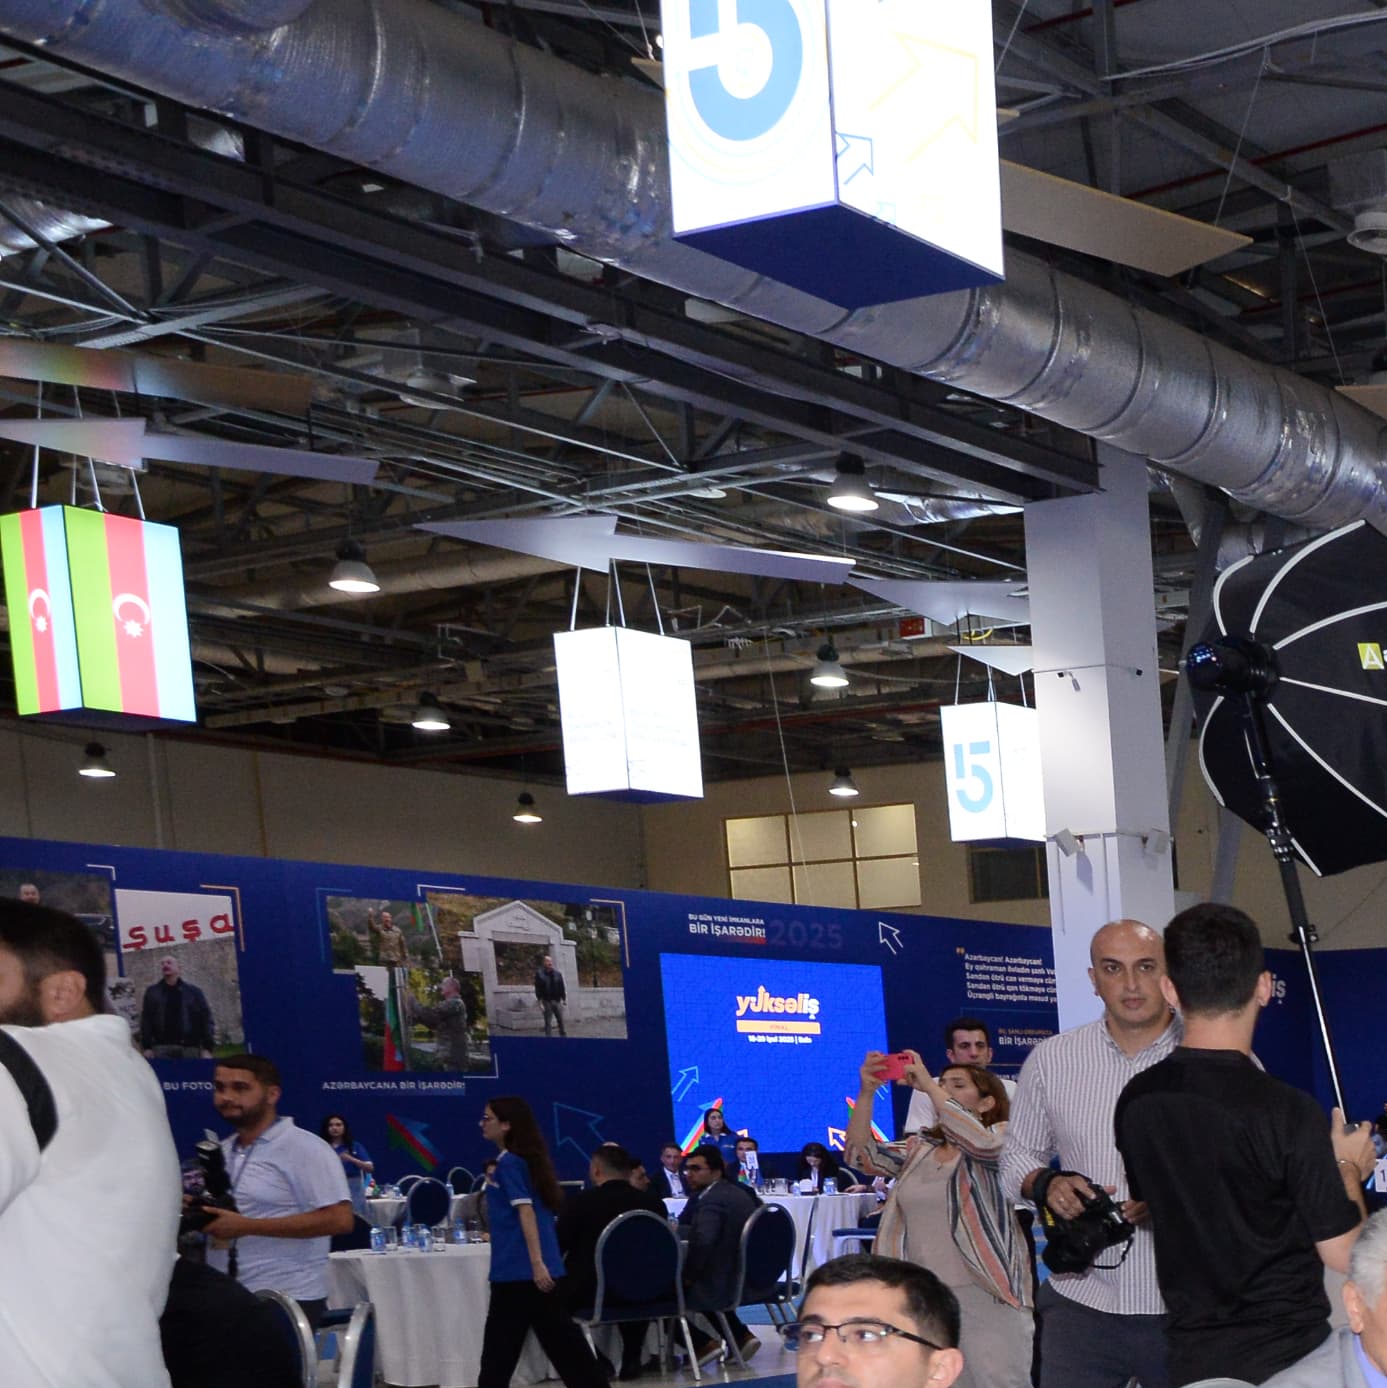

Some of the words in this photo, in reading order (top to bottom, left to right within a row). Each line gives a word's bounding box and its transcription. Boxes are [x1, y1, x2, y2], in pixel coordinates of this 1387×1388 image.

[689, 921, 709, 934] BİR
[711, 922, 766, 938] İŞARƏDİR!
[769, 919, 843, 949] 2025
[736, 984, 820, 1020] yüksəliş
[163, 1082, 179, 1090] BU
